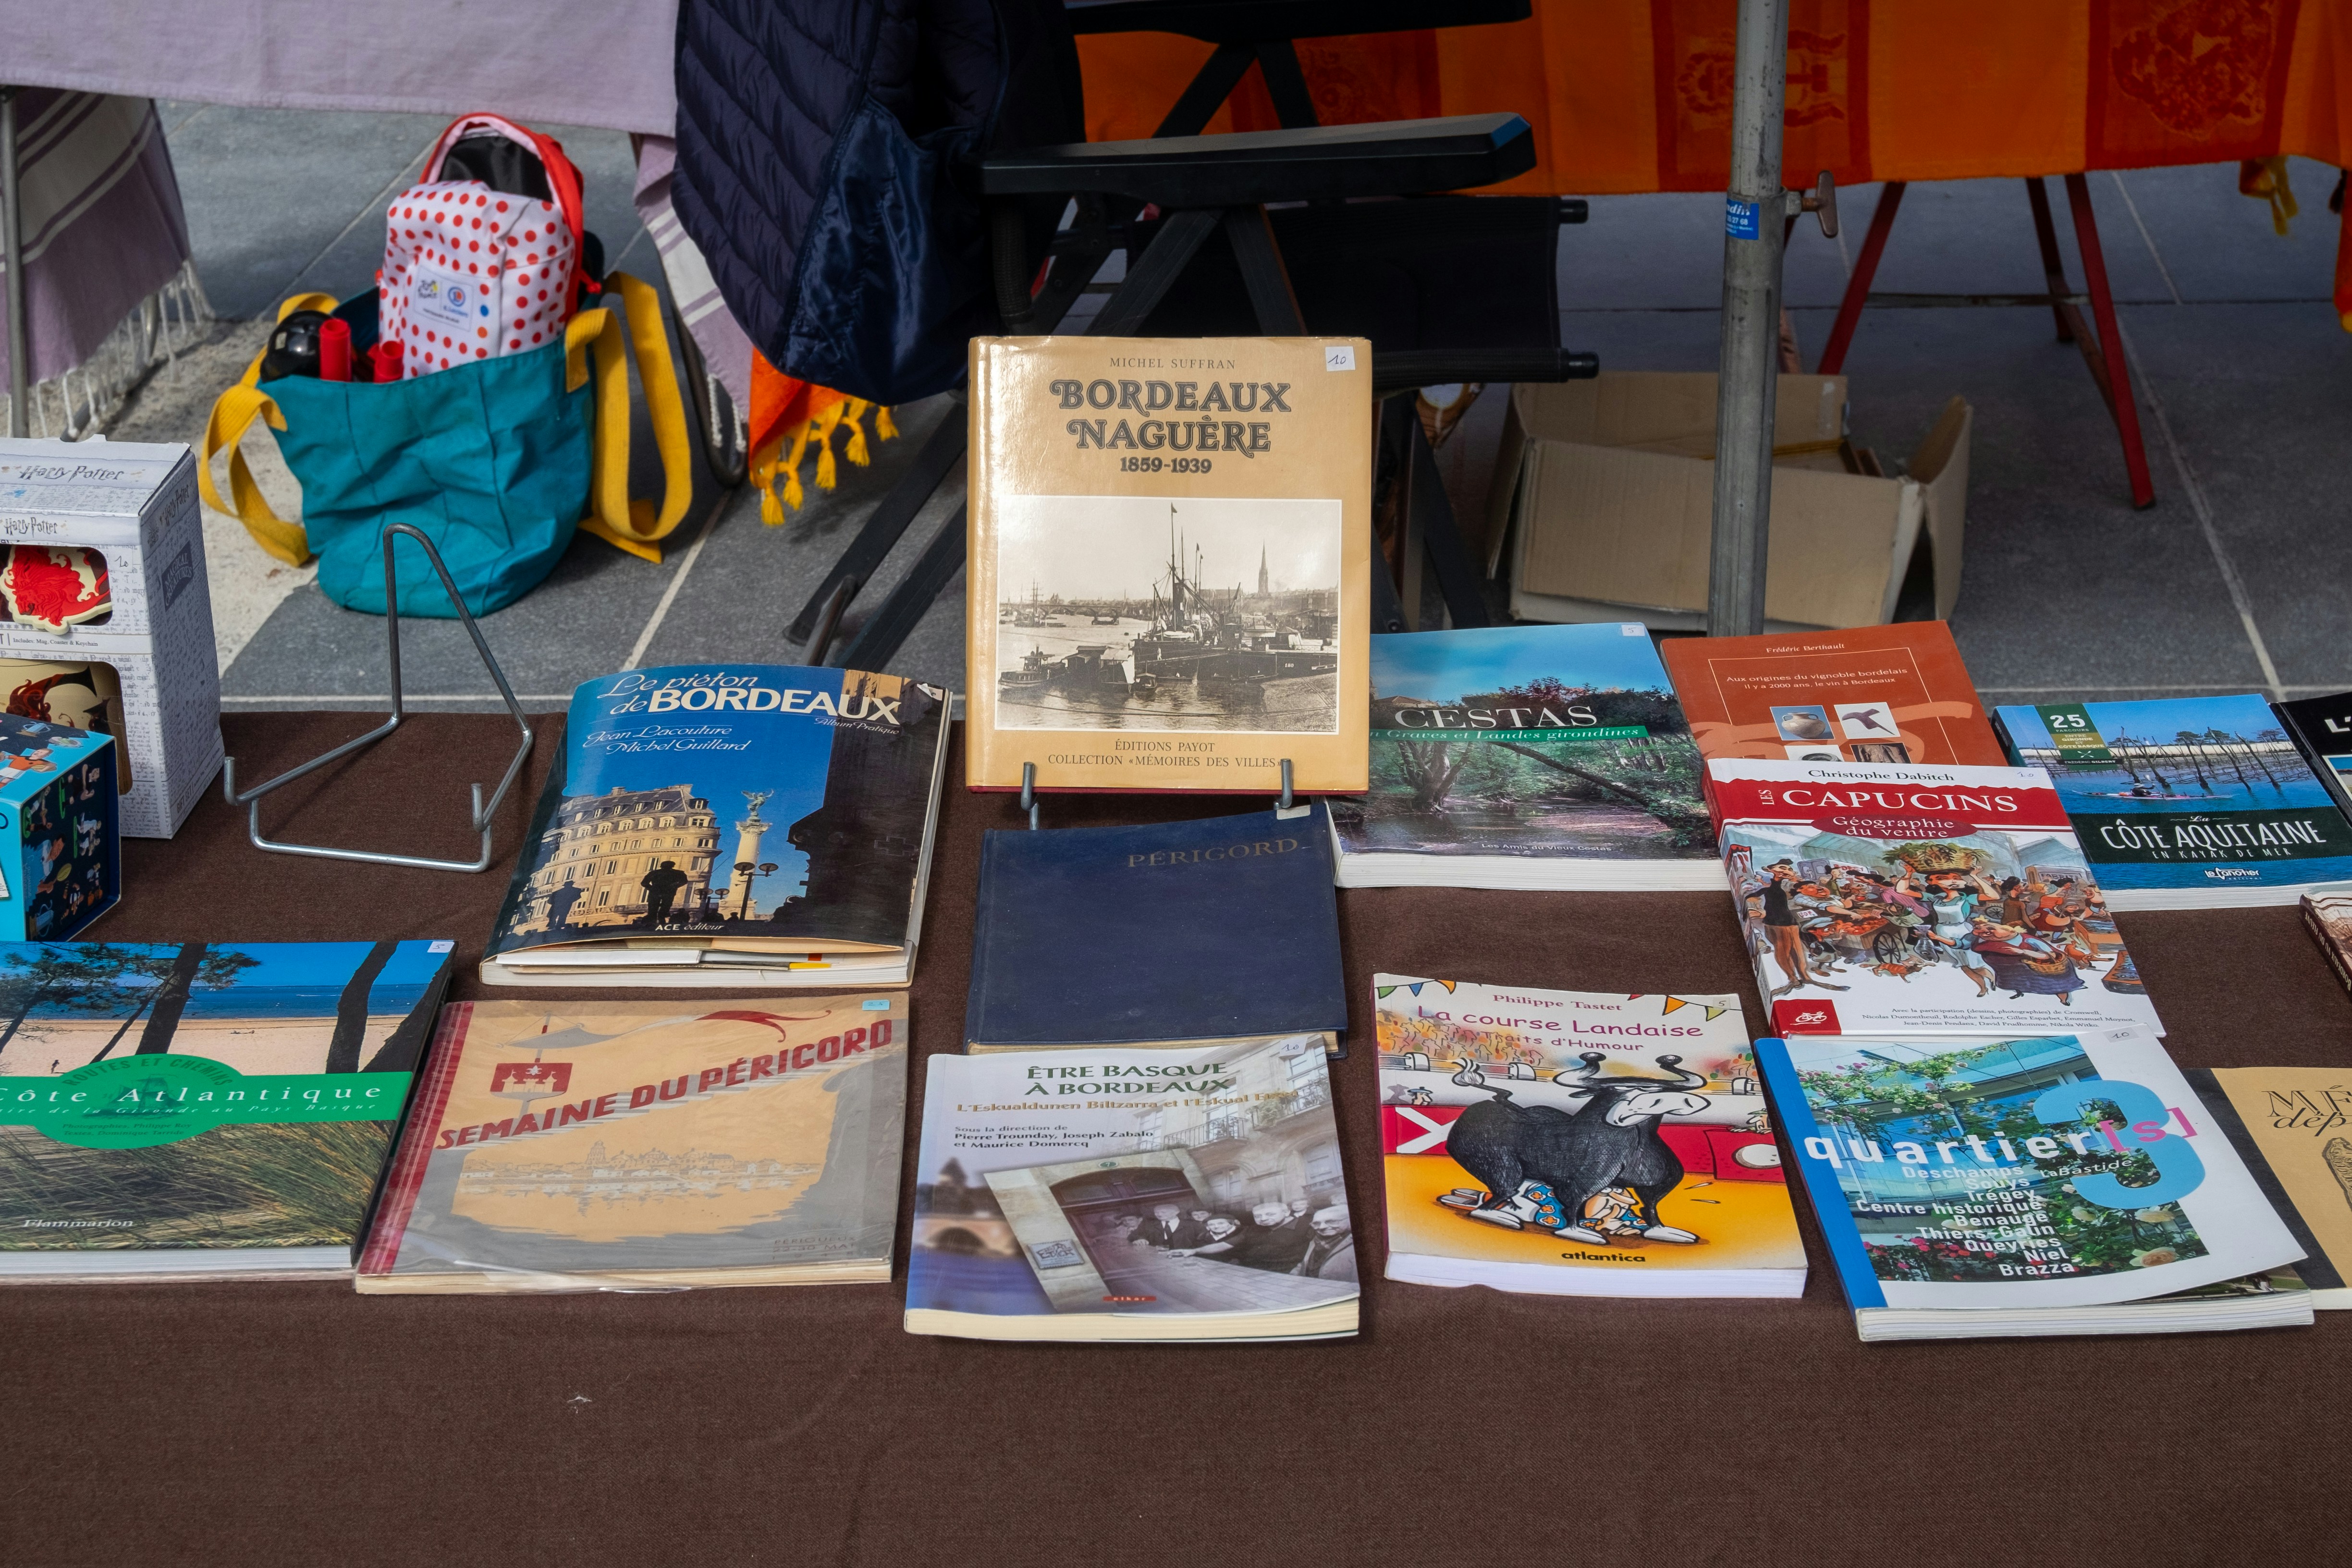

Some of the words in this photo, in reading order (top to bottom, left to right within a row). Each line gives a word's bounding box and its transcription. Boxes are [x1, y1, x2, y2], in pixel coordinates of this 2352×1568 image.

[1110, 357, 1164, 368] MICHEL
[1171, 358, 1237, 370] SUFFRAN
[1327, 355, 1347, 366] 10
[1049, 380, 1292, 417] BORDEAUX
[1066, 415, 1271, 458] NAGUÈRE
[19, 465, 72, 481] Harry
[68, 465, 125, 482] Potter
[1120, 457, 1213, 475] 1859-1939
[4, 517, 30, 536] Harry
[29, 516, 58, 538] Potter
[164, 552, 189, 589] MAGICAL
[165, 566, 193, 607] CREATURES
[1803, 643, 1845, 651] Berthault
[1749, 674, 1791, 682] origines
[1810, 672, 1856, 681] vignoble
[1858, 667, 1908, 676] bordelais
[597, 674, 658, 699] Le
[659, 672, 759, 690] piéton
[609, 695, 648, 715] de
[648, 687, 902, 725] BORDEAUX
[1395, 706, 1597, 728] CESTAS
[2049, 714, 2086, 728] 25
[814, 717, 853, 729] Album
[853, 722, 900, 735] Pratique
[583, 731, 630, 747] Jean
[632, 725, 732, 738] Lacouture
[1387, 730, 1448, 739] Graves
[1476, 730, 1540, 740] Landes
[1546, 728, 1639, 742] girondines
[606, 739, 674, 755] Michel
[674, 739, 752, 751] Guillard
[1115, 739, 1172, 752] ÉDITIONS
[1178, 741, 1215, 753] PAYOT
[1048, 754, 1123, 765] COLLECTION
[1206, 756, 1229, 767] DES
[1808, 769, 1891, 781] Christophe
[1894, 772, 1955, 784] Dabitch
[1759, 788, 1775, 806] LES
[1782, 789, 2018, 813] CAPUCINS
[1833, 815, 1955, 831] Géographie
[1846, 824, 1874, 836] du
[1879, 826, 1949, 838] ventre
[2100, 819, 2170, 849] CÔTE
[2175, 821, 2327, 851] AQUITAINE
[2180, 850, 2228, 858] KAYAK
[2238, 849, 2254, 858] DE
[2263, 848, 2291, 857] MER
[684, 922, 725, 931] éditeur
[2305, 912, 2318, 935] FLEUVE
[2331, 951, 2352, 991] BORDEAUX
[1492, 993, 1564, 1009] Philippe
[1571, 1000, 1623, 1012] Tastet
[1717, 999, 1727, 1007] 5
[1418, 1005, 1452, 1021] La
[1462, 1014, 1562, 1031] course
[1573, 1019, 1704, 1037] Landaise
[1482, 1030, 1543, 1045] Traits
[1551, 1036, 1644, 1052] d'Humour
[62, 1060, 131, 1086] ROUTES
[141, 1058, 163, 1067] ET
[170, 1058, 233, 1086] CHEMINS
[1027, 1065, 1094, 1079] ÊTRE
[1102, 1062, 1228, 1079] BASQUE
[435, 1092, 620, 1151] SEMAINE
[628, 1075, 691, 1110] DU
[698, 1018, 893, 1093] PÉRIGORD
[1024, 1081, 1051, 1095] À
[1057, 1078, 1230, 1094] BORDEAUX
[117, 1087, 381, 1103] Atlantique
[248, 1105, 292, 1114] Pays
[957, 1102, 1081, 1113] L'Eskualdunen
[1086, 1100, 1159, 1110] Biltzarra
[1062, 1131, 1105, 1139] Joseph
[2033, 1079, 2206, 1210] 3
[1901, 1166, 2024, 1181] Deschamps
[1965, 1178, 2031, 1191] Souys
[1856, 1200, 1926, 1214] Centre
[1932, 1201, 2043, 1216] historique
[22, 1218, 134, 1228] Flammarion
[1953, 1213, 2048, 1227] Benauge
[1915, 1225, 2056, 1240] Thiers-Galin
[1963, 1237, 2062, 1254] Queyries
[1561, 1250, 1647, 1263] atlantica
[2022, 1248, 2069, 1262] Niel
[1998, 1262, 2075, 1276] Brazza
